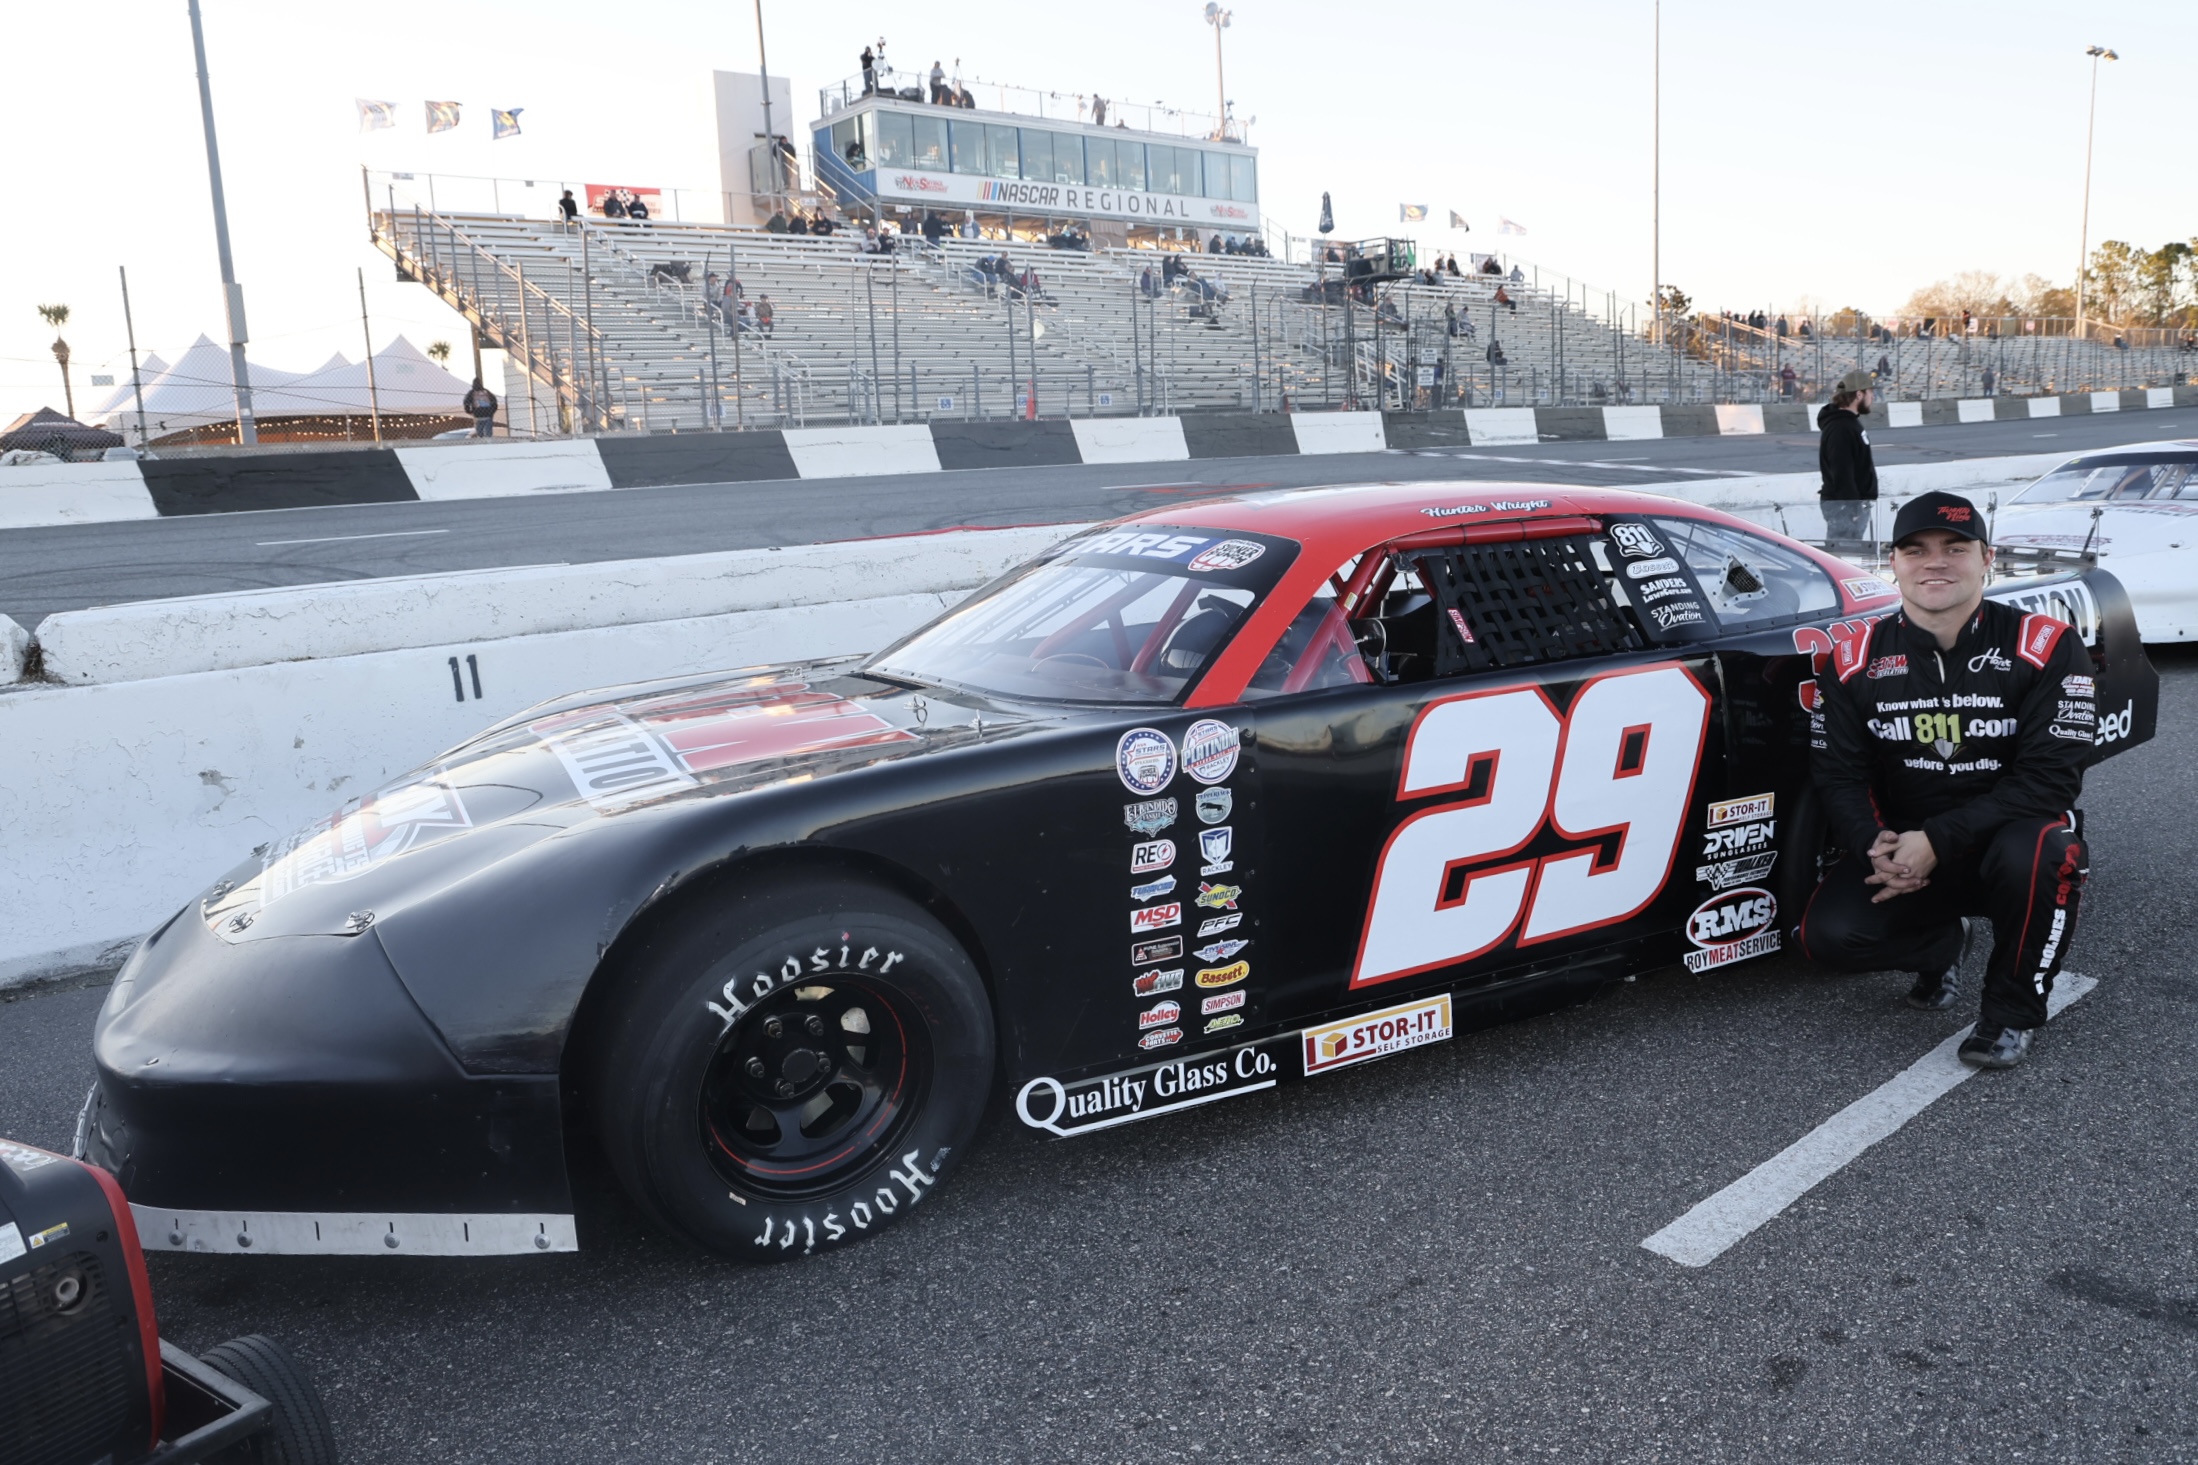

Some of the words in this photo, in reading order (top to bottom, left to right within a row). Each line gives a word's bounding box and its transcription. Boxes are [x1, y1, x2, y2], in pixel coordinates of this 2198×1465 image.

[997, 182, 1059, 206] NASCAR
[1067, 189, 1189, 217] REGIONAL
[1420, 503, 1487, 517] Hunter
[1490, 500, 1548, 513] Wright
[1614, 526, 1653, 546] 811
[1640, 578, 1687, 595] SANDERS
[1651, 601, 1700, 618] STANDING
[1658, 610, 1703, 628] Ovation
[2033, 625, 2055, 653] SIMPSON
[448, 654, 482, 702] 11
[2072, 675, 2094, 685] DAY
[1876, 701, 1909, 713] Know
[1910, 697, 1939, 710] what
[1952, 693, 2004, 708] below.
[1867, 716, 1912, 741] Call
[1914, 712, 1962, 744] 811
[2049, 724, 2077, 739] Quality
[1184, 731, 1239, 766] PLATINUM
[1948, 759, 1974, 775] you
[1975, 758, 2002, 772] dig.
[1730, 800, 1767, 818] STOR-IT
[1751, 810, 1773, 819] STORAGE
[1348, 659, 1712, 990] 29
[1703, 820, 1775, 855] DRIVEN
[1707, 842, 1768, 861] SUNGLASSES
[1202, 862, 1233, 874] RACKLEY
[1200, 888, 1237, 904] SUNOCO
[1134, 904, 1180, 925] MSD
[1201, 914, 1239, 931] PFC
[1694, 896, 1772, 941] RMS
[2039, 908, 2067, 969] HOLMES
[1201, 965, 1242, 984] Bassett
[708, 945, 904, 1026] Hoosier
[1205, 994, 1242, 1011] SIMPSON
[1140, 1007, 1180, 1025] Holley
[1145, 1030, 1179, 1042] CORVETTE
[1353, 1010, 1437, 1049] STOR-IT
[1145, 1037, 1166, 1047] PARTS
[1377, 1041, 1401, 1054] SELF
[1404, 1027, 1450, 1048] STORAGE
[1016, 1075, 1147, 1136] Quality
[1153, 1060, 1228, 1098] Glass
[1235, 1046, 1277, 1077] Co.
[754, 1149, 936, 1254] Hoosier
